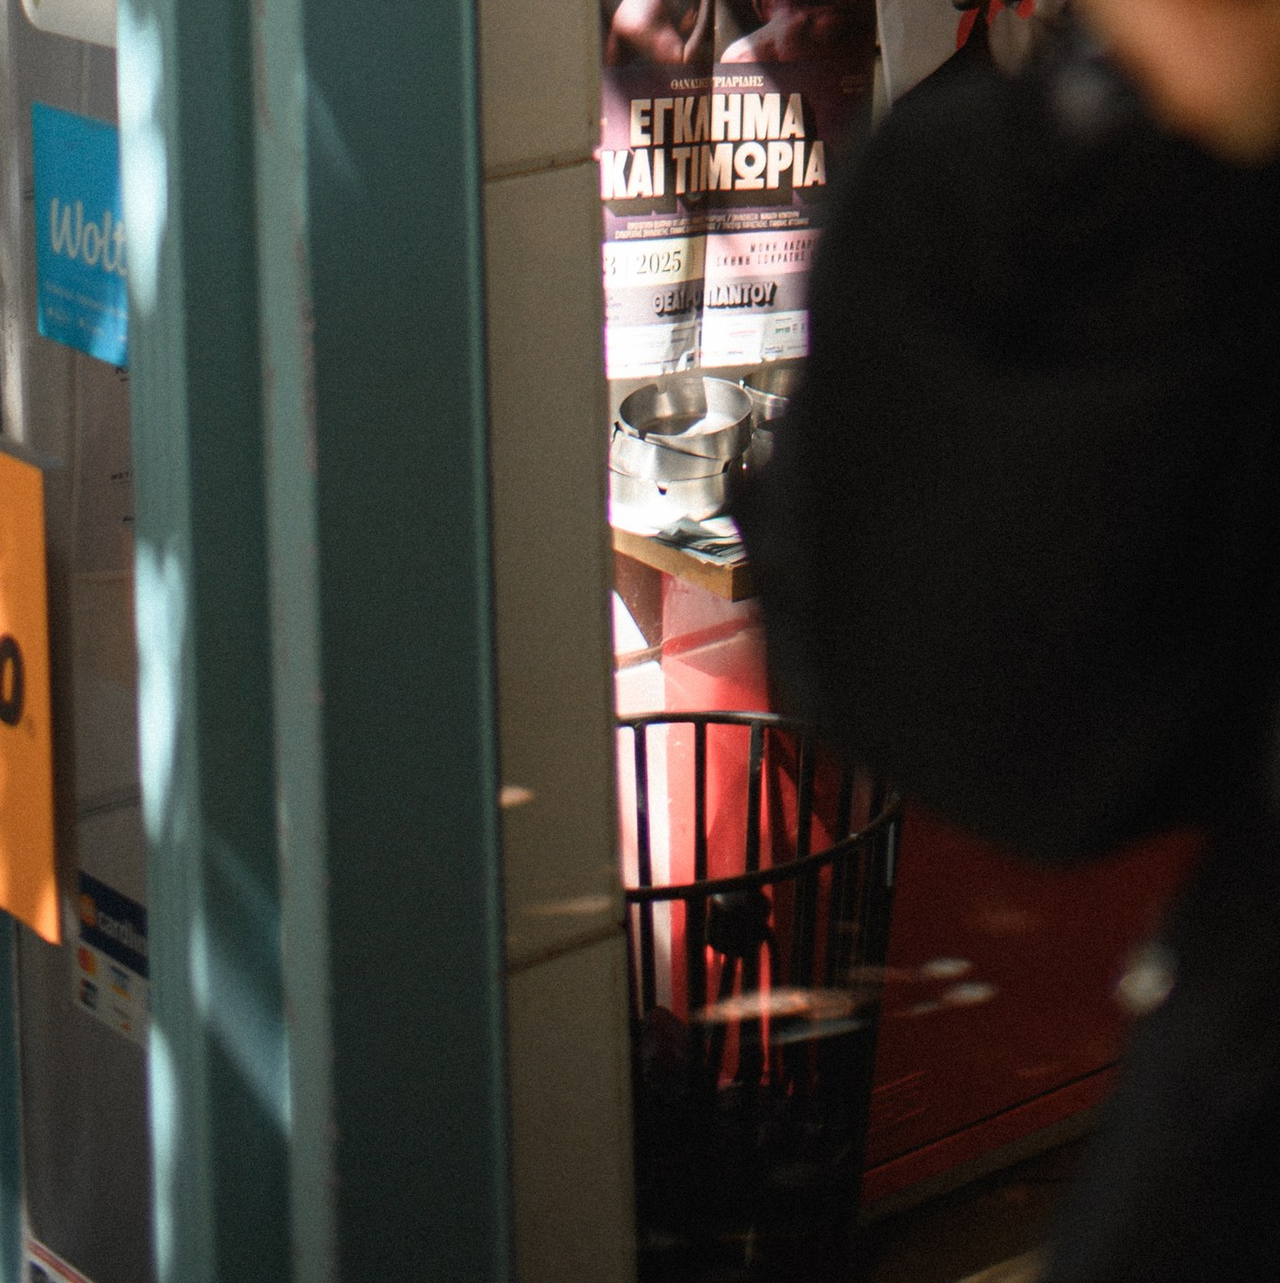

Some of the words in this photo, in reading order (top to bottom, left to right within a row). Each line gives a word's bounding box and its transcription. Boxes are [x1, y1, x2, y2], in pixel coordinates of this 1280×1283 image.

[630, 92, 806, 148] ΕΓΚΛΗΜΑ
[600, 148, 665, 201] ΚΑΙ
[671, 140, 827, 196] ΤΙΜΩΡΙΑ
[50, 196, 127, 277] Wolt
[636, 250, 683, 276] 2025
